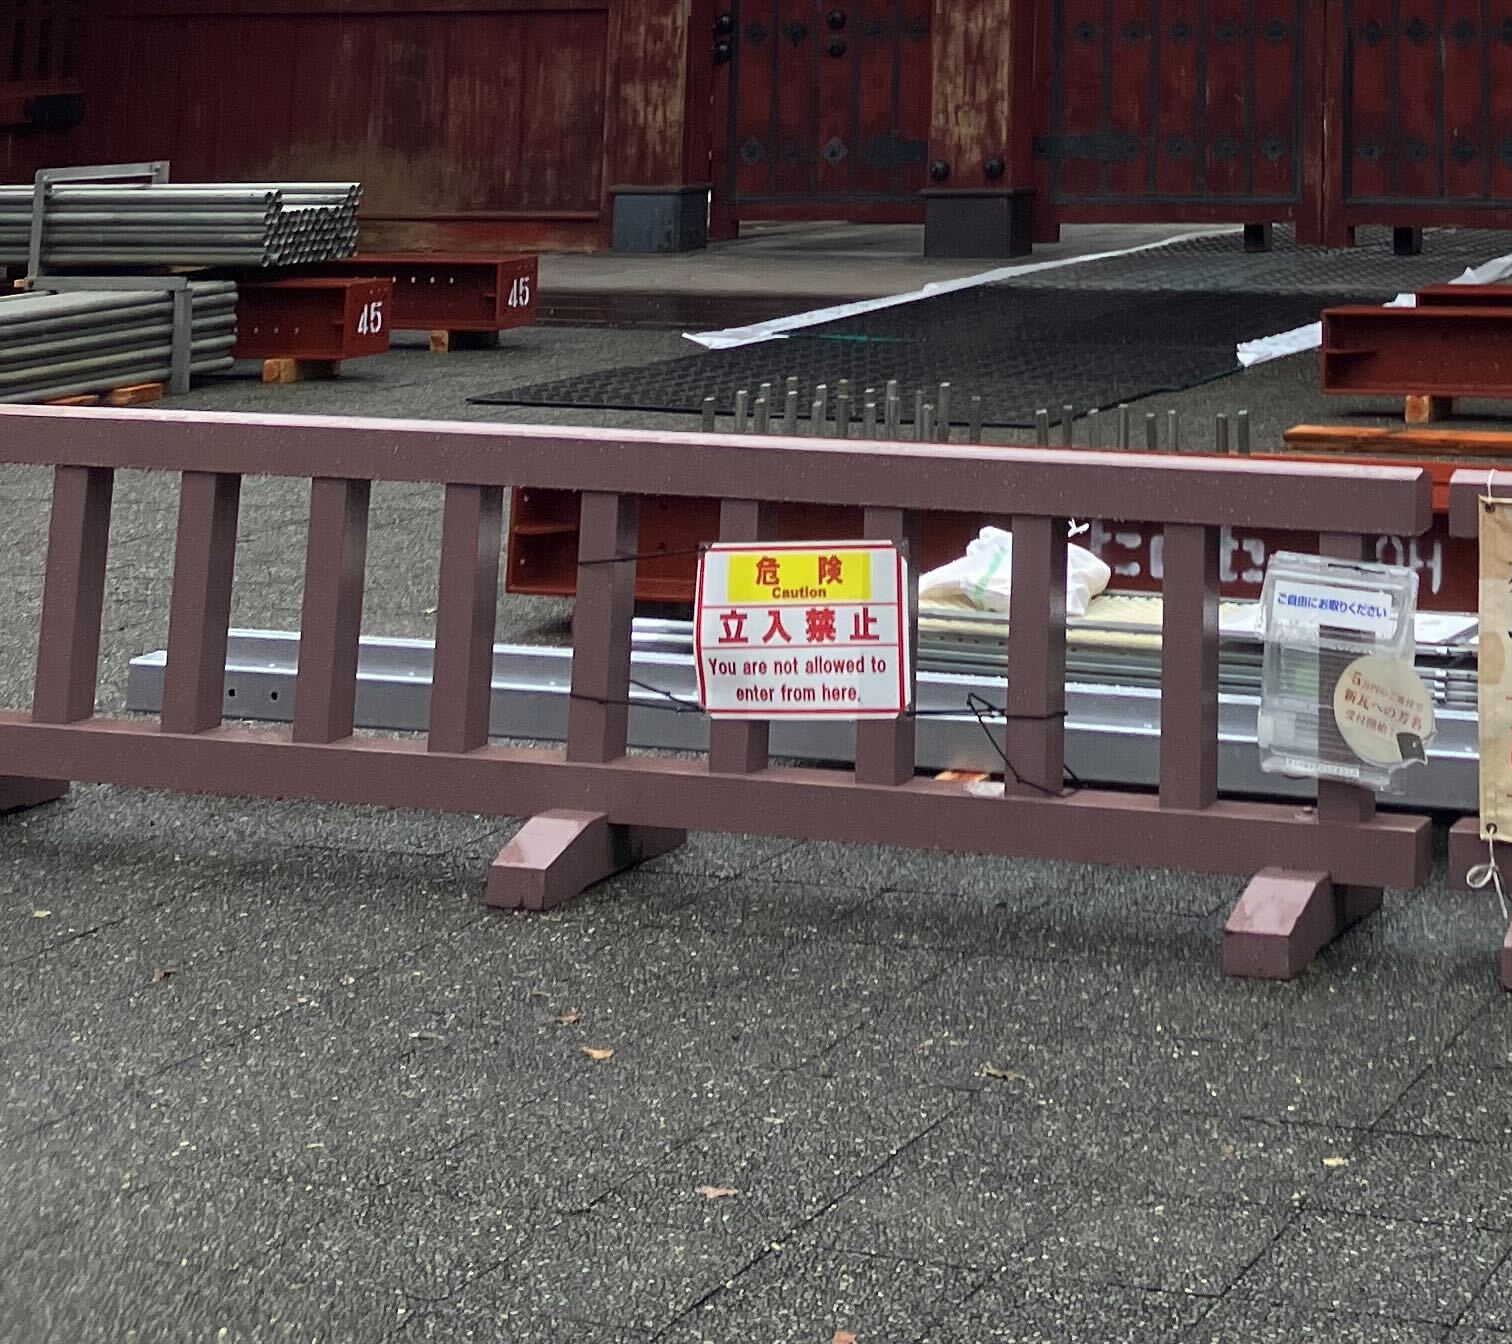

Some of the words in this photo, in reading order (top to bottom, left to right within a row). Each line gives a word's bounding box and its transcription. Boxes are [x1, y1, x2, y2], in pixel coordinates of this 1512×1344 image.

[507, 277, 530, 307] 45
[357, 301, 383, 335] 45
[772, 586, 826, 599] Caution
[1278, 593, 1387, 618] ご自由にお取りください
[718, 607, 880, 643] 立入禁止
[709, 657, 736, 675] You
[744, 660, 767, 674] are
[774, 657, 798, 674] not
[806, 656, 864, 674] allowed
[871, 656, 886, 672] to
[736, 686, 775, 702] enter
[781, 684, 815, 701] from
[822, 683, 861, 701] here.
